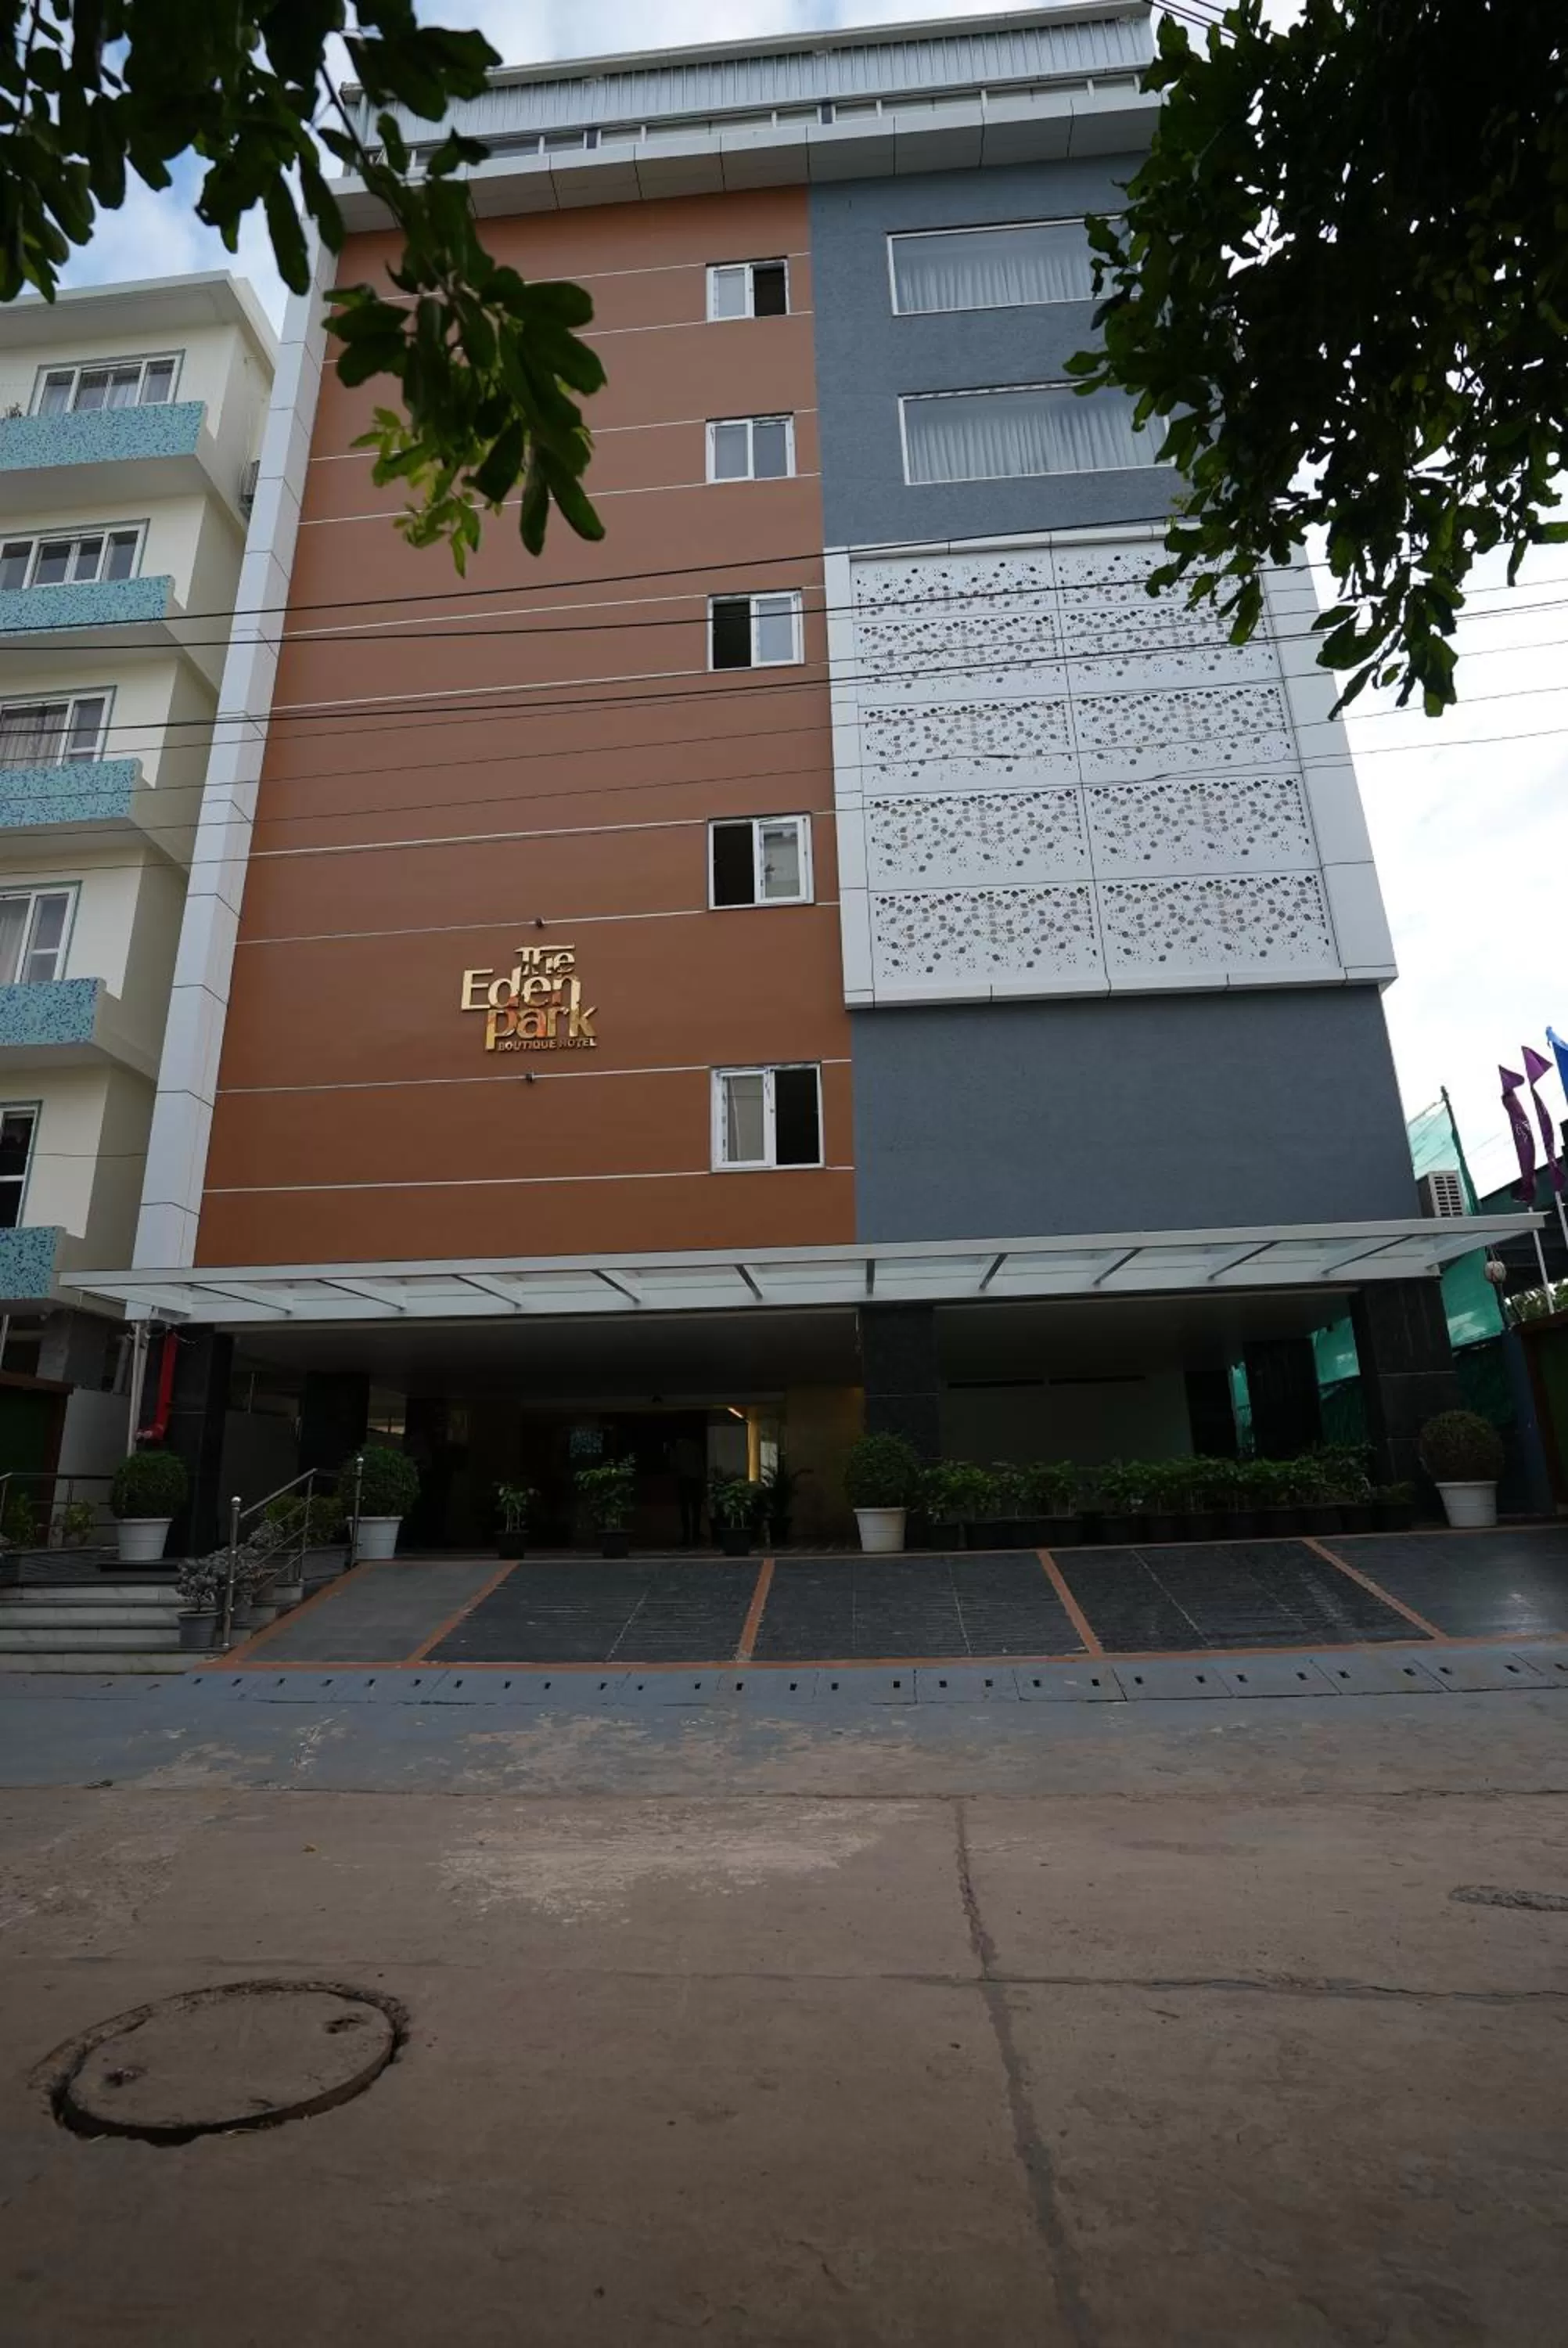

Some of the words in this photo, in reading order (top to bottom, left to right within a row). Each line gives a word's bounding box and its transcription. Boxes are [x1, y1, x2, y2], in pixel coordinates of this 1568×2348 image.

[461, 967, 581, 1011] Eden
[485, 1006, 598, 1050] park
[498, 1039, 556, 1051] BOUTIQUE
[559, 1038, 597, 1049] HOTEL
